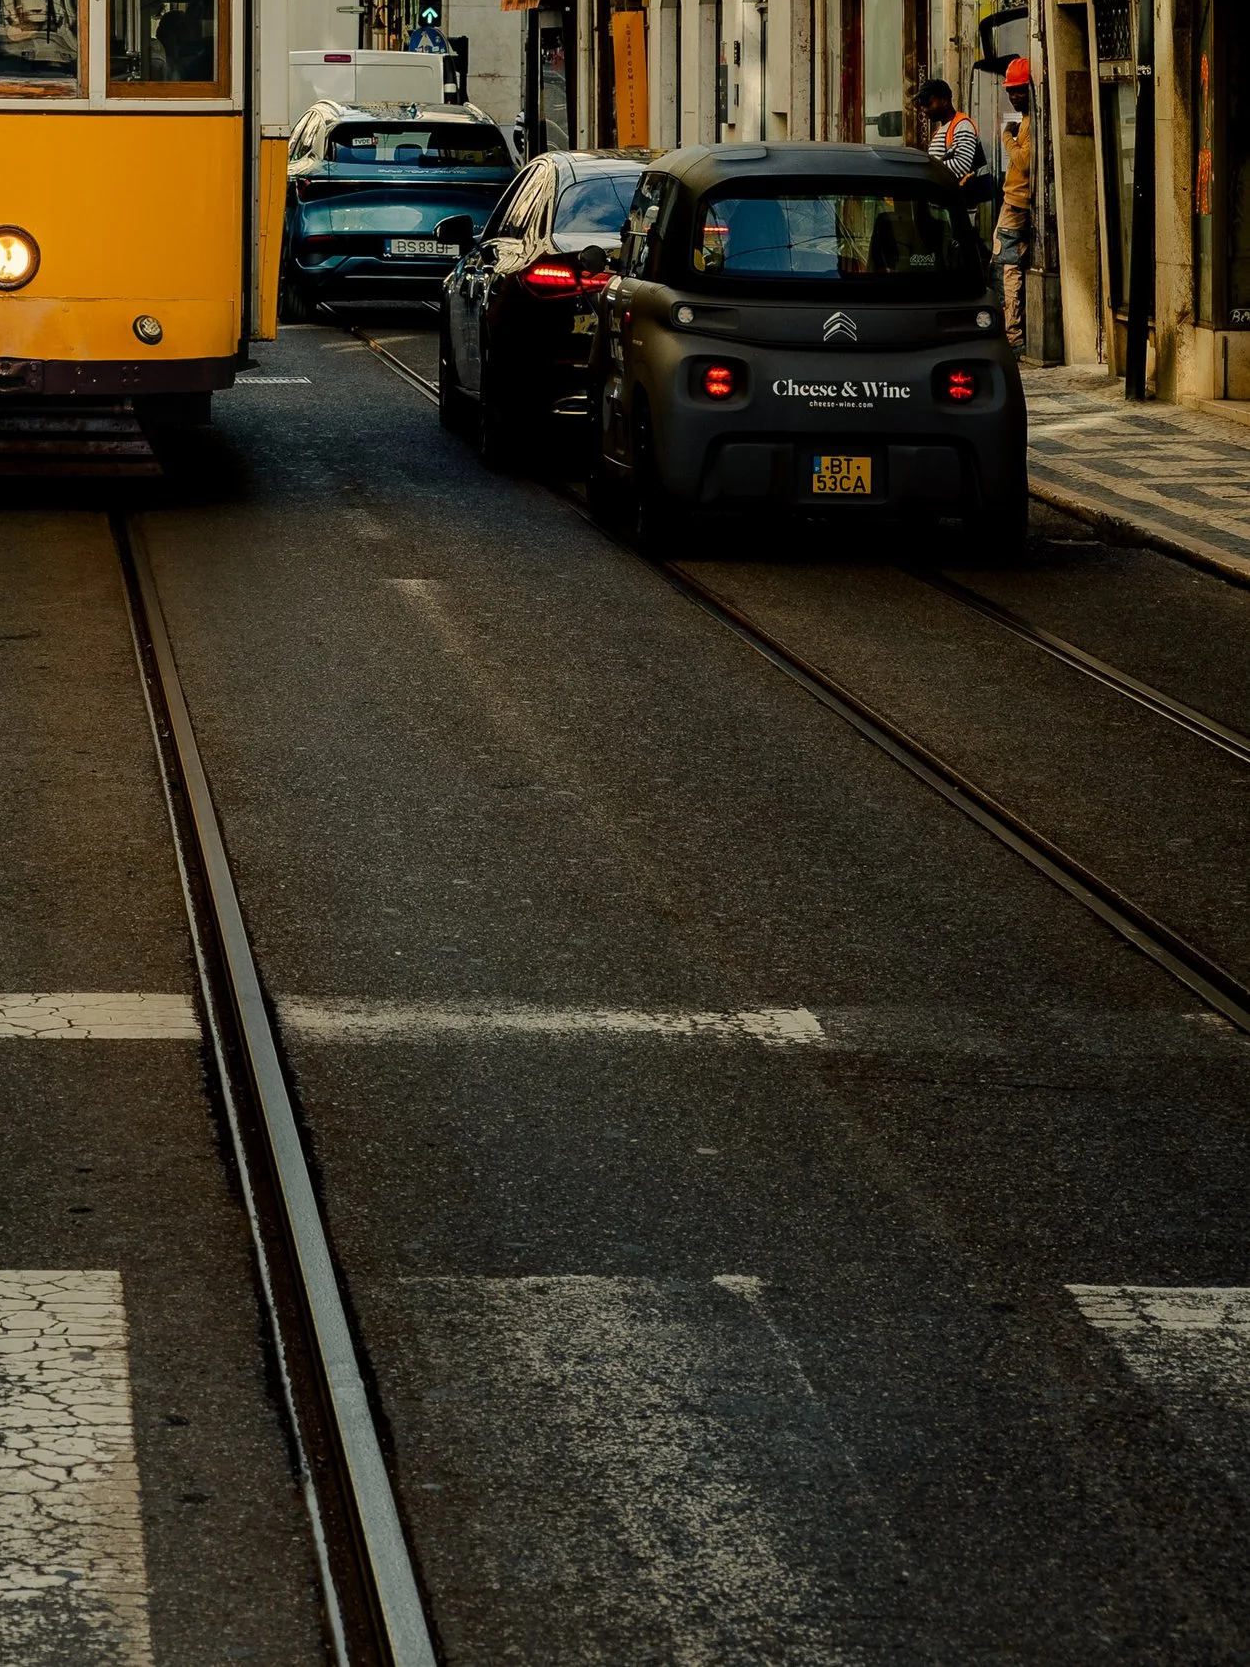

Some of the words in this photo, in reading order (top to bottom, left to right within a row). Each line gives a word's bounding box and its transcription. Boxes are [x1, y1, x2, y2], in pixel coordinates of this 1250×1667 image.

[772, 379, 837, 397] Cheese
[841, 381, 859, 397] &
[862, 382, 911, 399] Wine
[809, 400, 874, 408] cheese-wine.com
[817, 475, 866, 493] 53CA
